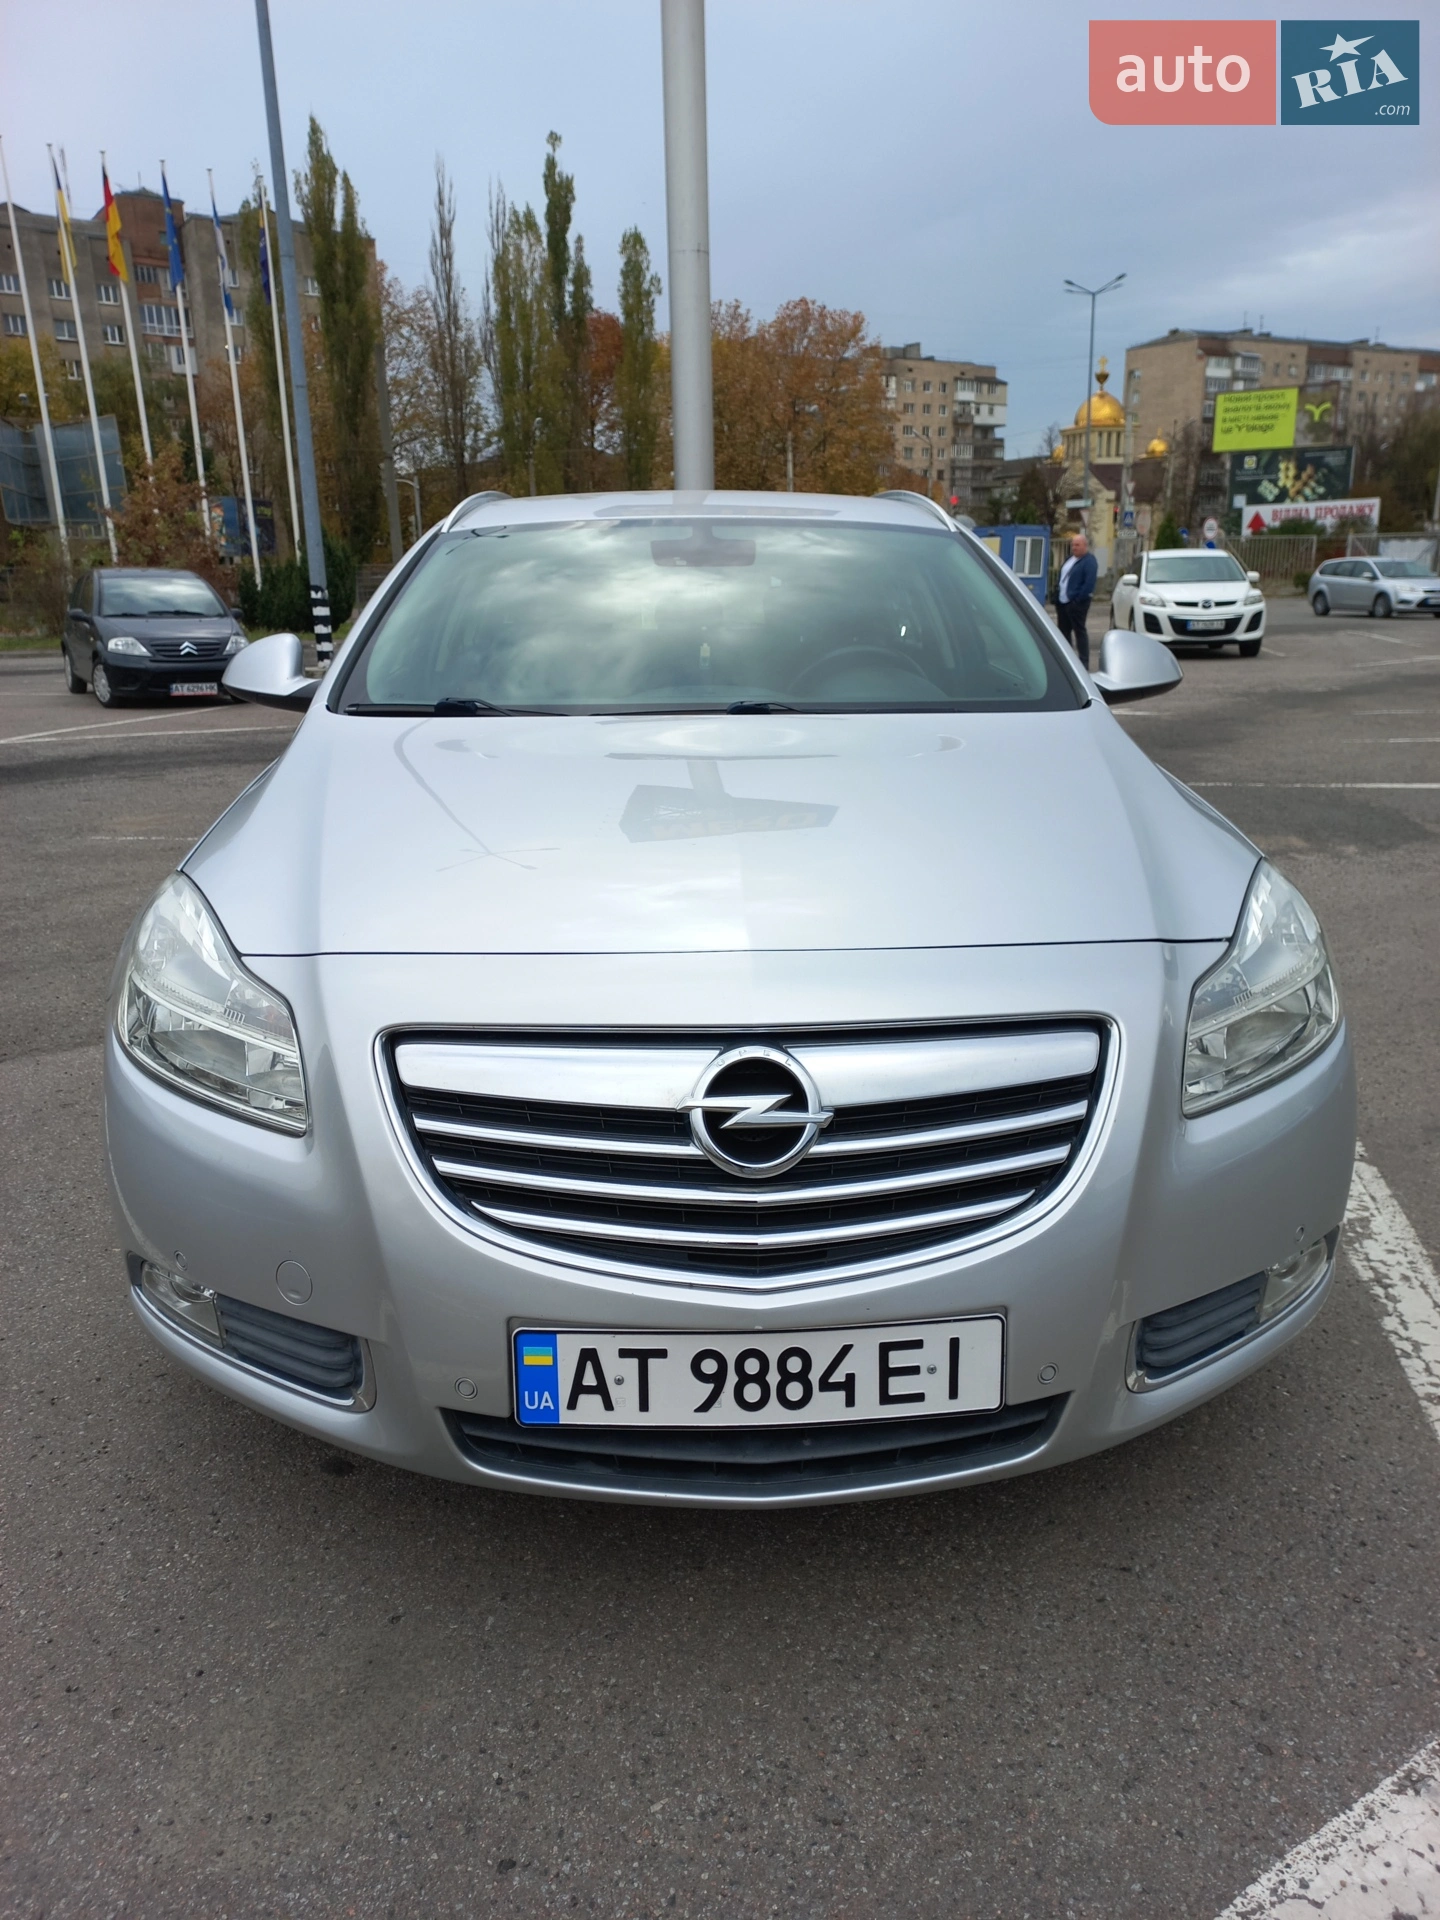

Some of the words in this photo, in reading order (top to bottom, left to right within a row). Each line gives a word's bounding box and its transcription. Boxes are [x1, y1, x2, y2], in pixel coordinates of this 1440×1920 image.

[566, 1347, 668, 1412] AT
[690, 1343, 856, 1413] 9884
[878, 1336, 961, 1406] EI
[524, 1391, 554, 1410] UA
